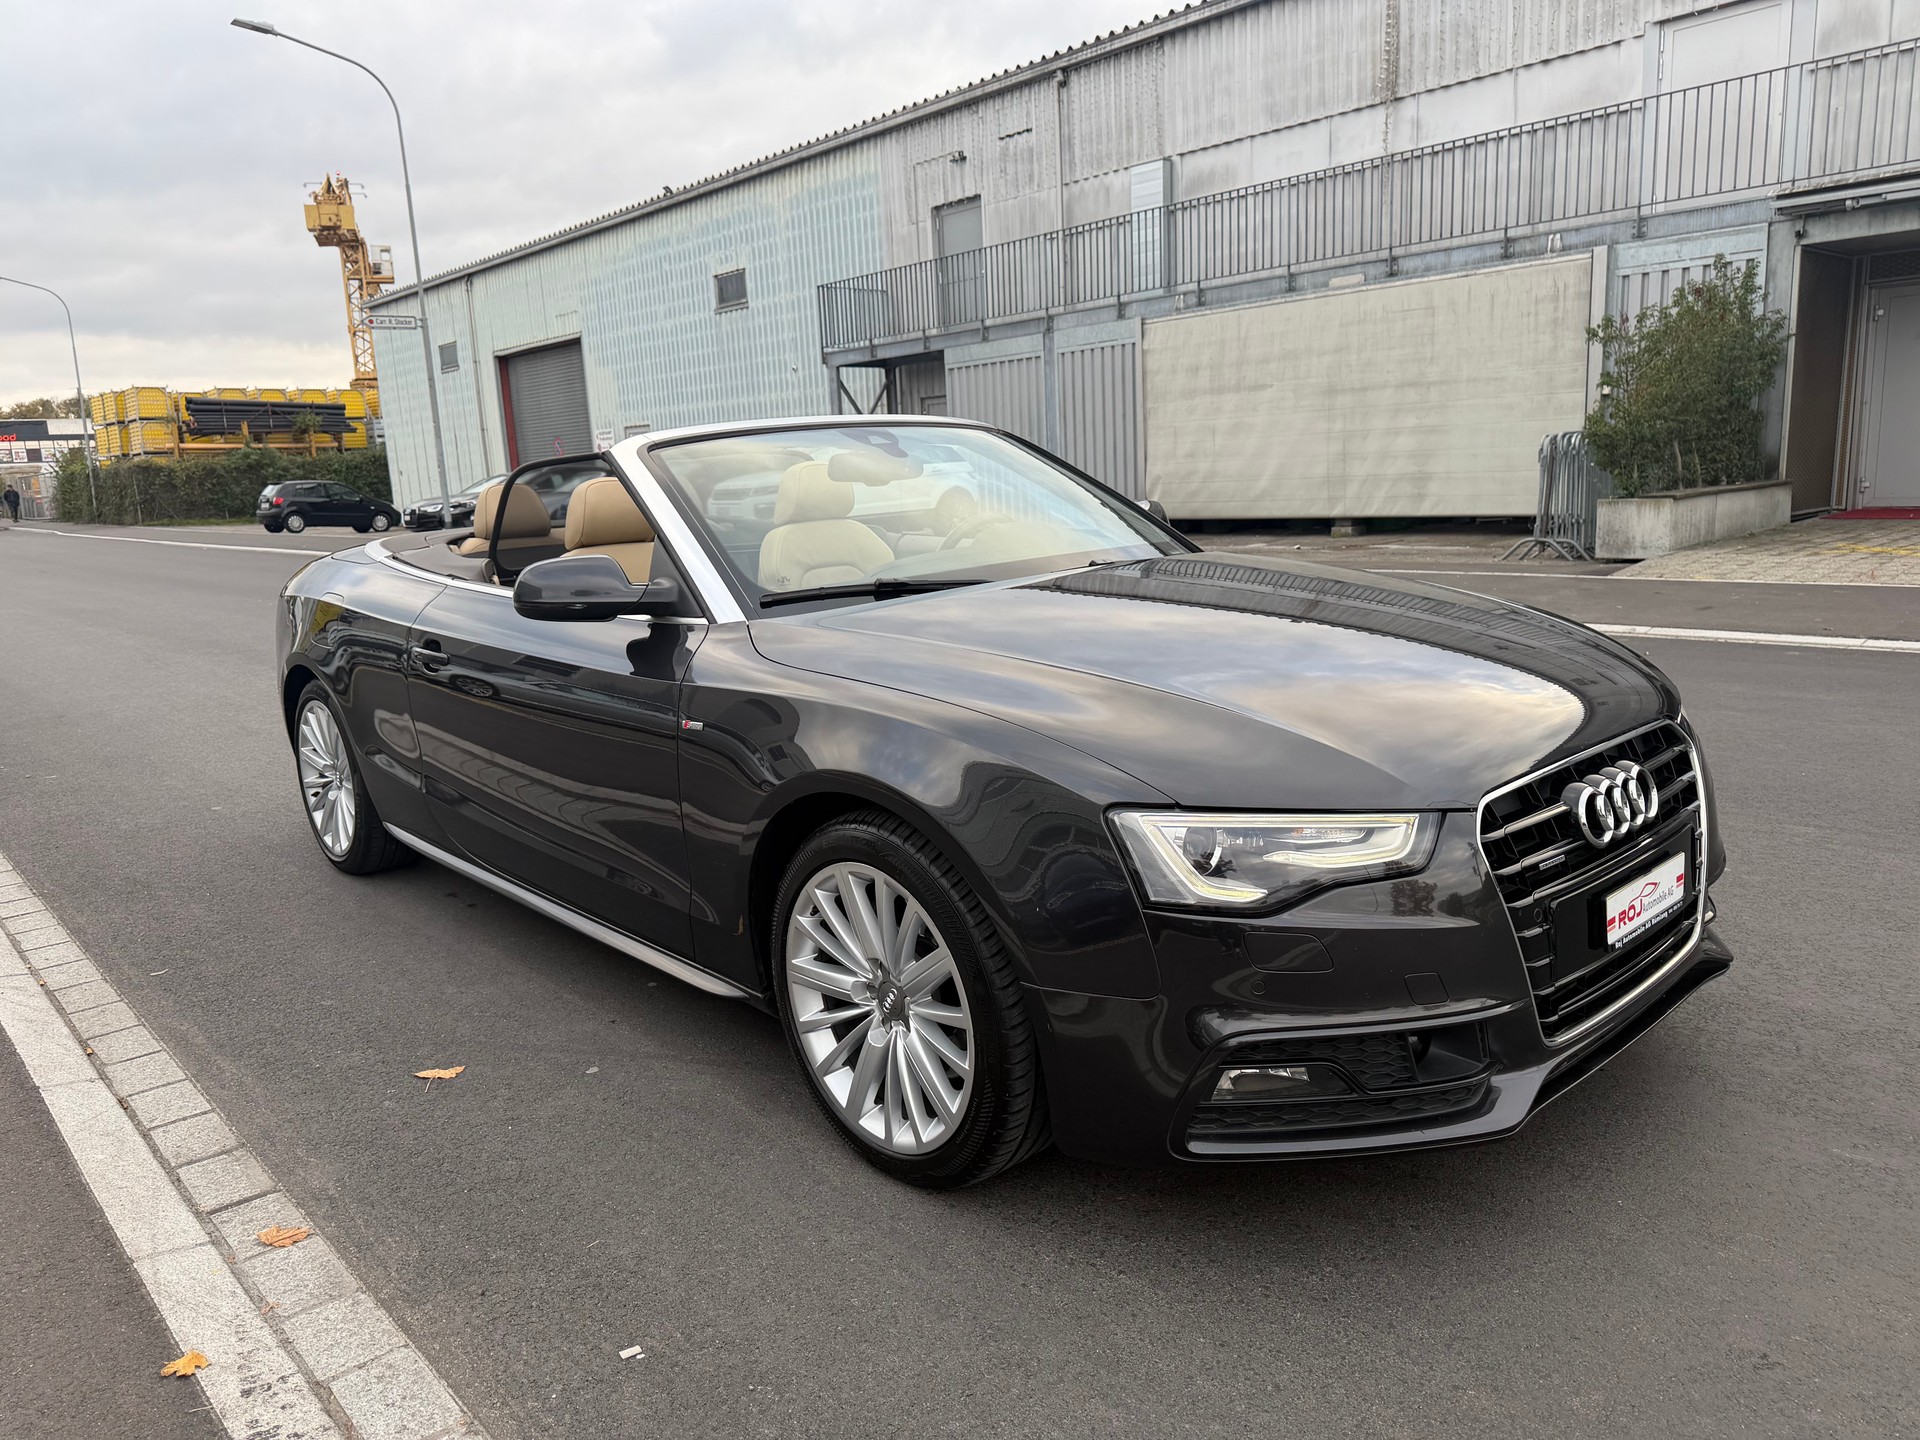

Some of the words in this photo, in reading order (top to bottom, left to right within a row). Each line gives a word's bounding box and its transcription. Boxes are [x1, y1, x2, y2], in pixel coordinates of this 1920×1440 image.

[1618, 898, 1643, 930] ROJ
[1643, 892, 1667, 913] Automobile
[1615, 939, 1623, 949] Roj
[1623, 925, 1646, 944] Automobile
[1645, 920, 1652, 930] AG
